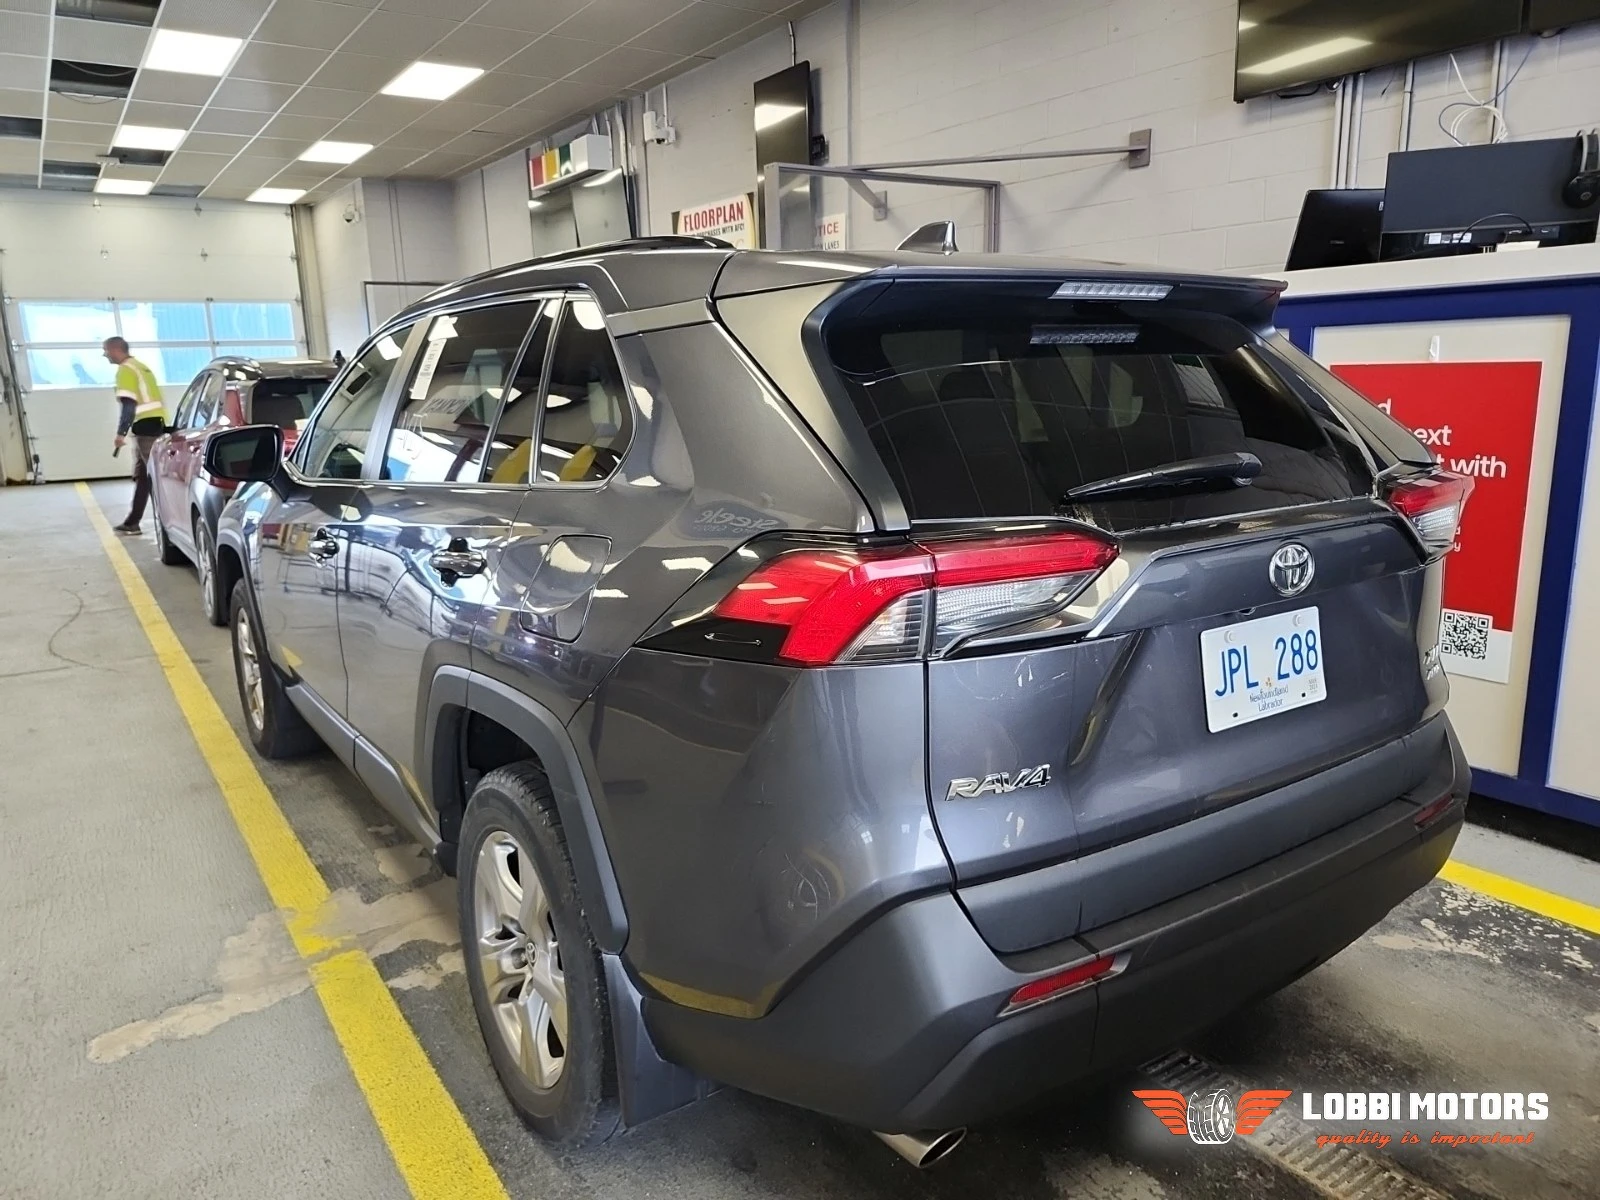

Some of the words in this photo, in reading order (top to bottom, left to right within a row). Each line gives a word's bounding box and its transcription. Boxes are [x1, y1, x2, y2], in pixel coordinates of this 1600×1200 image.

[684, 201, 744, 233] FLOORPLAN
[1408, 425, 1452, 446] ext
[1450, 454, 1507, 478] with
[1215, 645, 1259, 697] JPL
[1275, 629, 1318, 681] 288
[1258, 698, 1284, 712] Labrador
[945, 763, 1051, 801] RAV4
